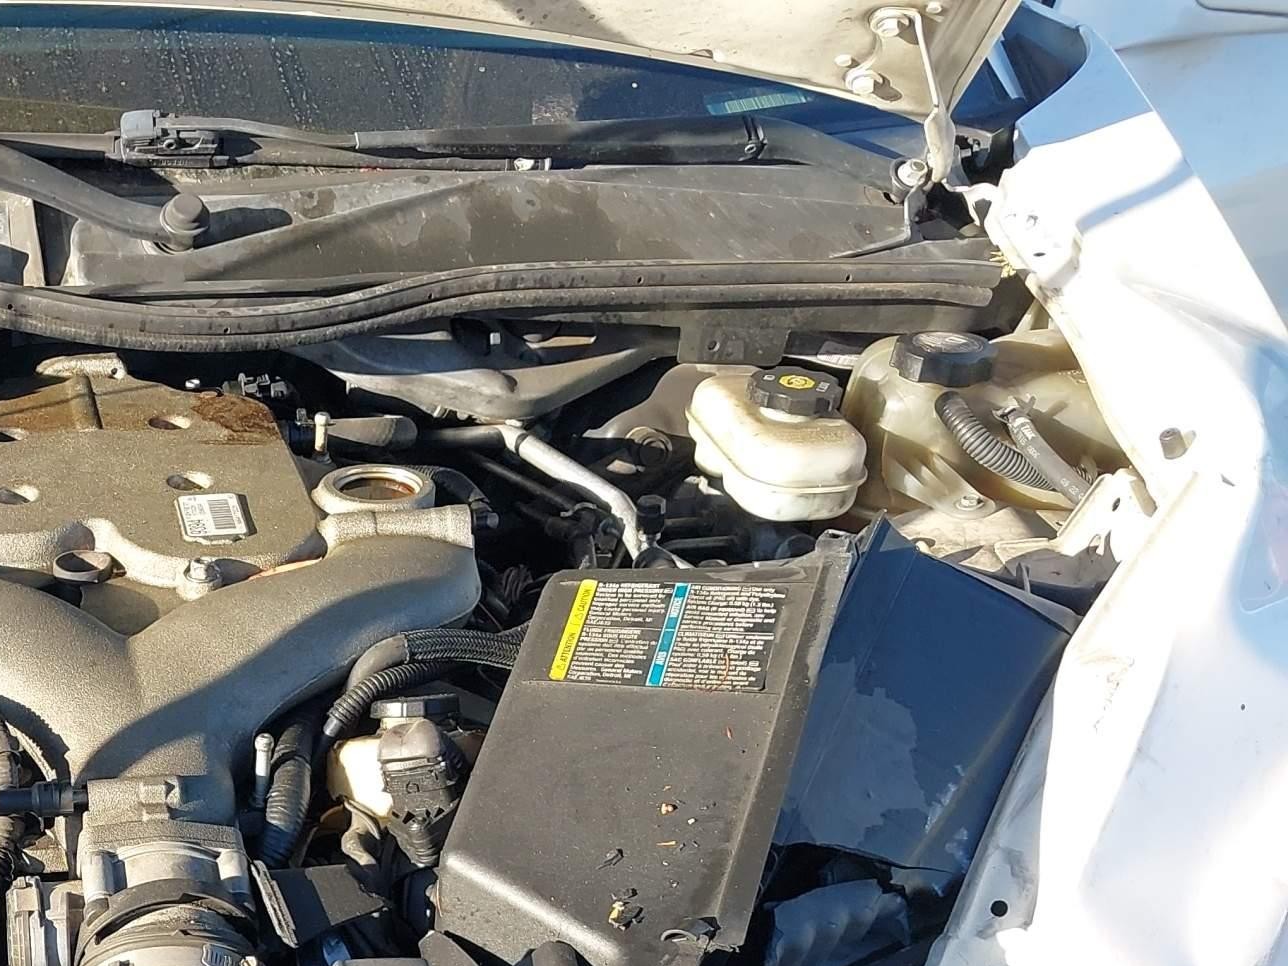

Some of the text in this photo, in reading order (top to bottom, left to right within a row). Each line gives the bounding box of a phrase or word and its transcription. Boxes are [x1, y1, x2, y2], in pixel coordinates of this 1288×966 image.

[577, 589, 591, 613] CAUTION
[669, 597, 684, 617] NOTICE
[559, 632, 577, 662] ATTENTION
